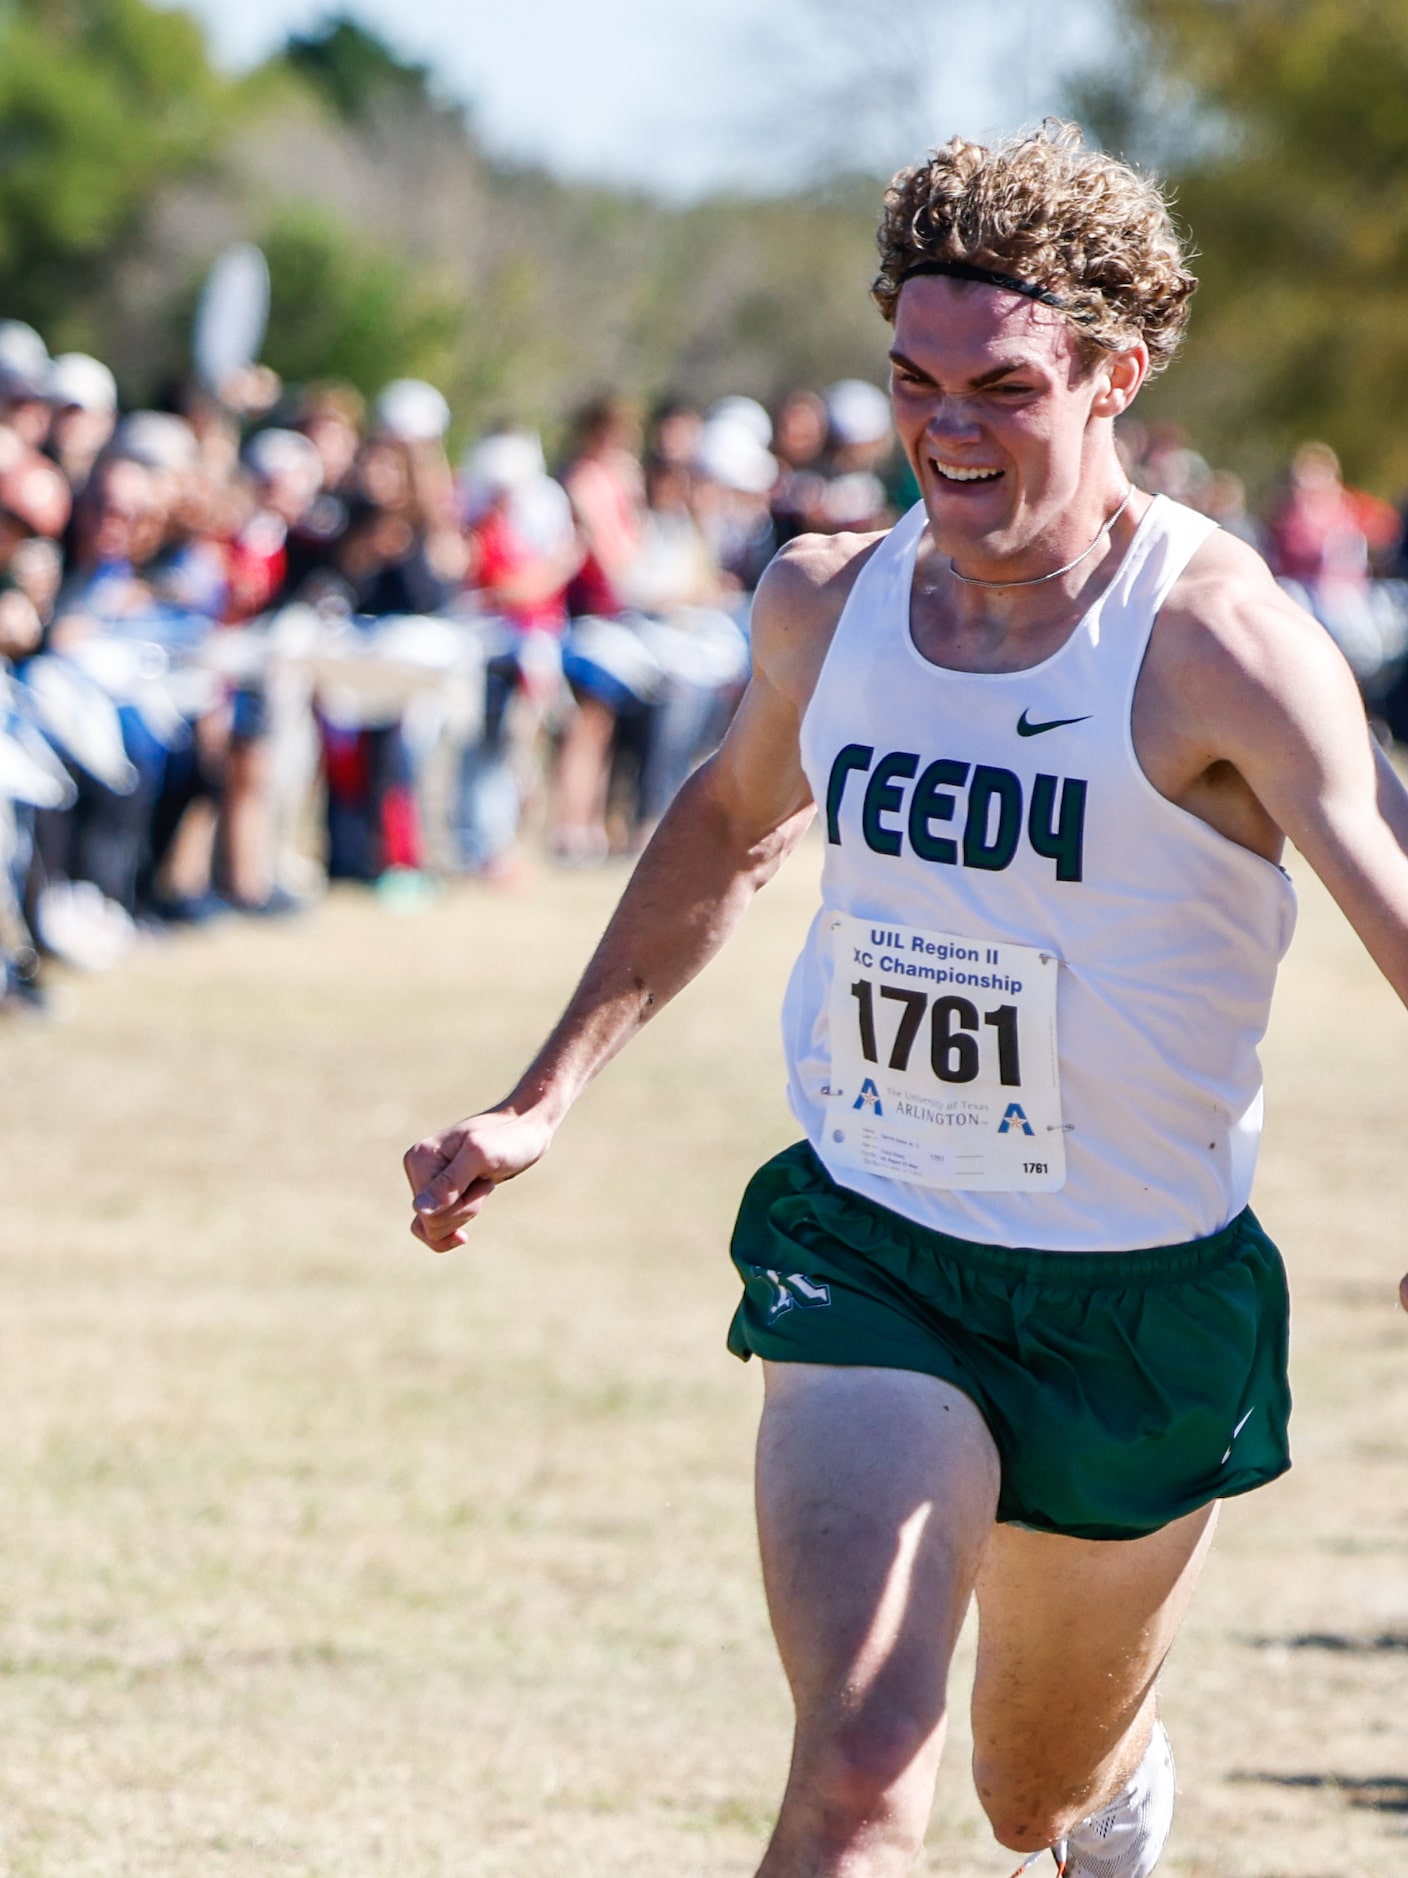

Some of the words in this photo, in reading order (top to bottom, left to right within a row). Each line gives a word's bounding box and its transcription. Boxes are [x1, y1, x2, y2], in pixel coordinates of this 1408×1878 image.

[871, 929, 904, 949] UIL
[911, 936, 979, 962] Region
[853, 947, 873, 968] XC
[879, 956, 1023, 995] Championship
[851, 978, 1021, 1087] 1761
[886, 1087, 902, 1098] The
[904, 1091, 945, 1111] University
[946, 1101, 958, 1110] of
[960, 1101, 989, 1111] Texas
[896, 1101, 979, 1126] ARLINGTON
[1023, 1162, 1048, 1175] 1761
